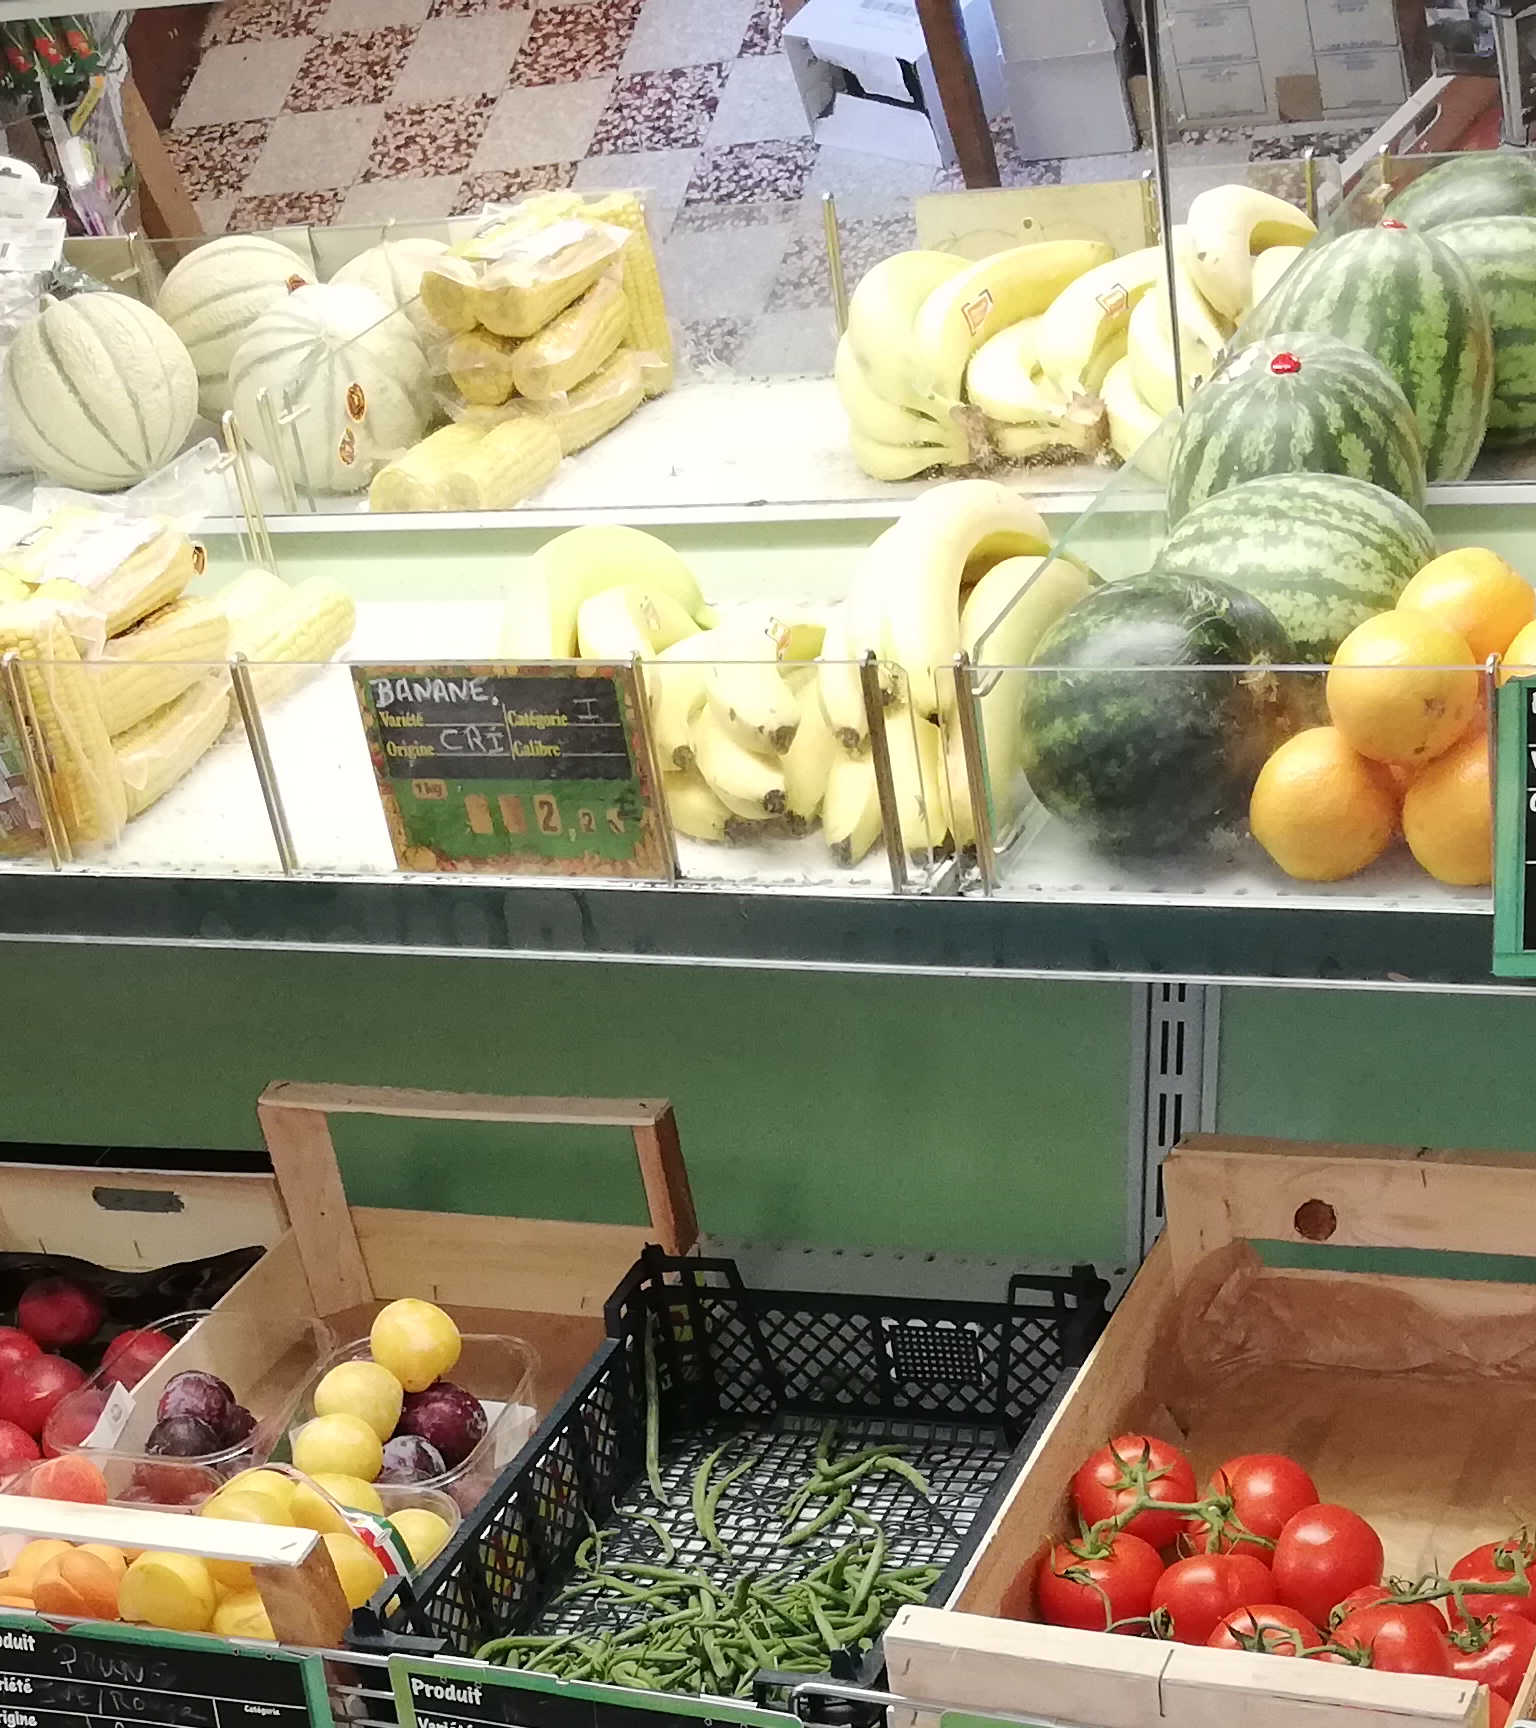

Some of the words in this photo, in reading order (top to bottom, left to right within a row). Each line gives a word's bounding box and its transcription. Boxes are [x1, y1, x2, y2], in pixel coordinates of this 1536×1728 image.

[508, 710, 568, 729] Catégorie
[513, 742, 561, 758] Calibre
[410, 1677, 483, 1706] Produit
